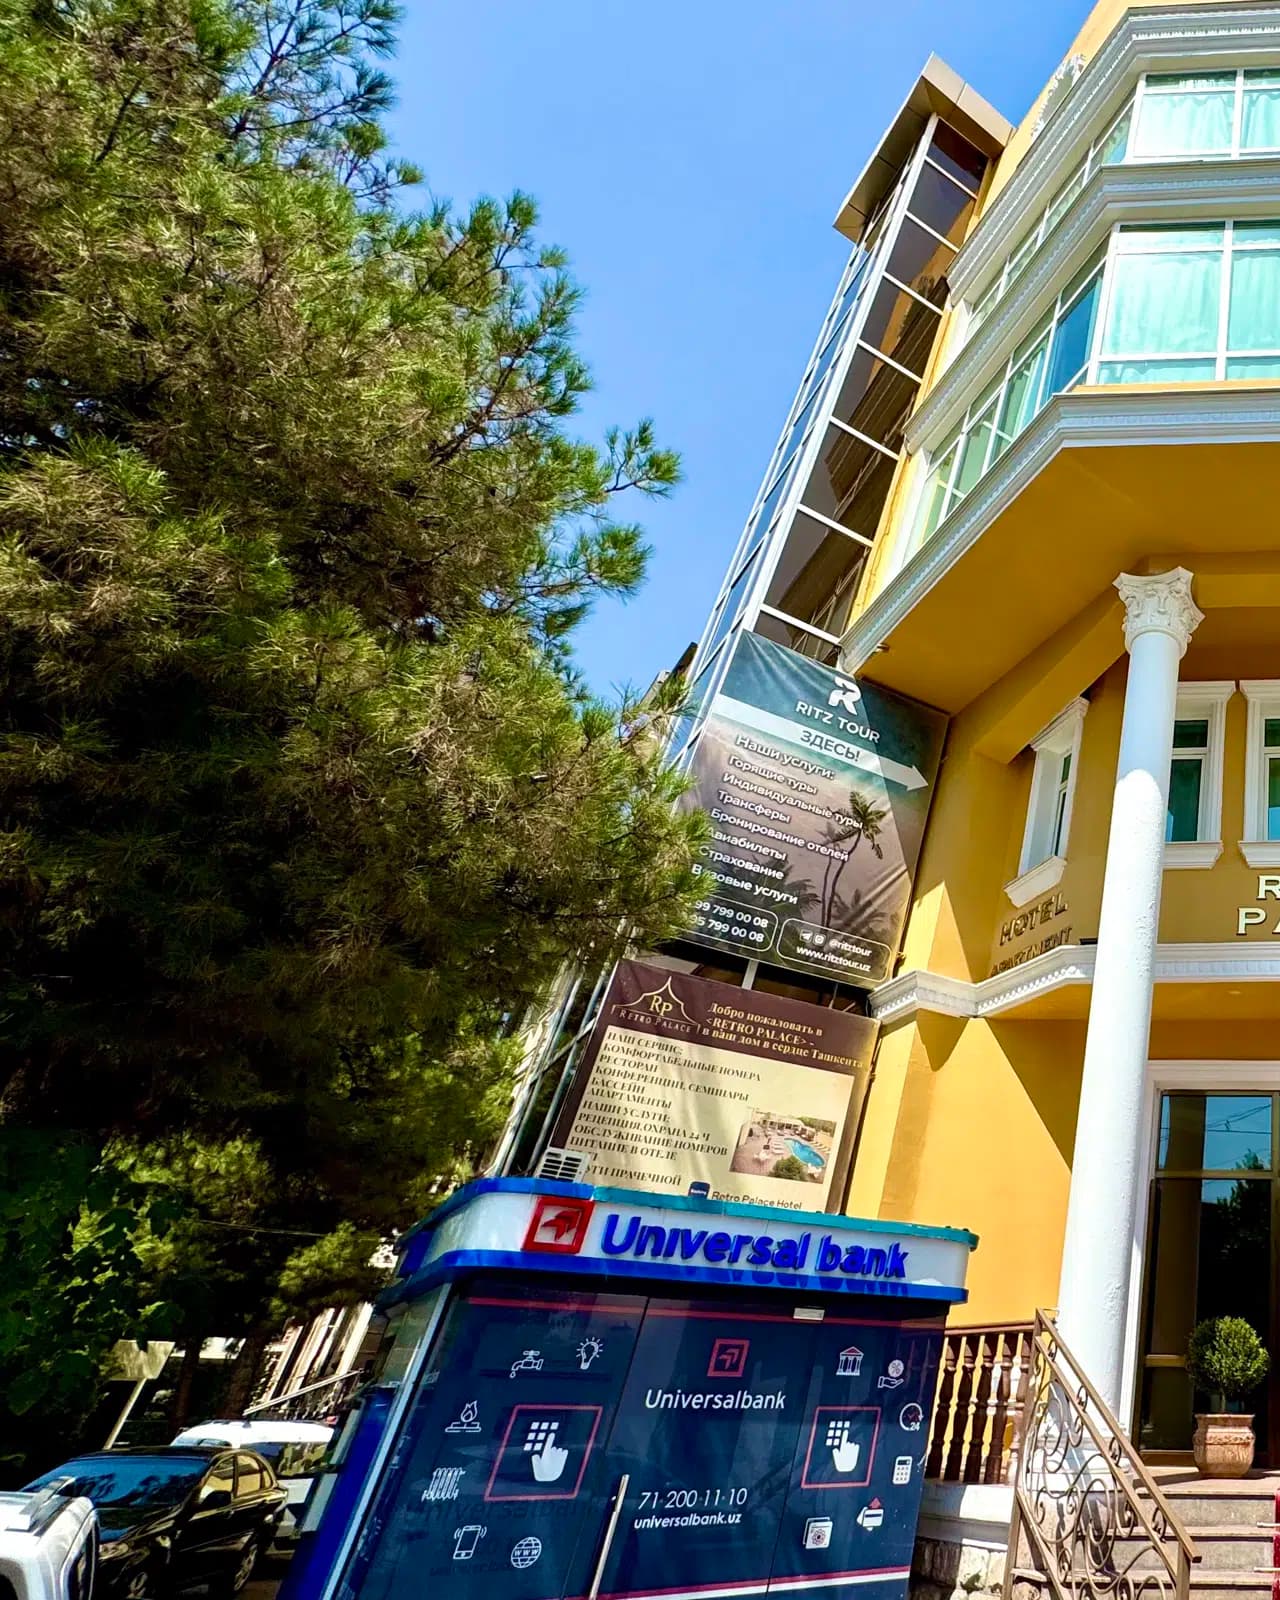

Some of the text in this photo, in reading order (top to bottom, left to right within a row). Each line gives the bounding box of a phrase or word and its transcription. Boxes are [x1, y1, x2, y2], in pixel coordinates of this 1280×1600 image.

[796, 700, 881, 744] RITZ TOUR
[735, 734, 835, 781] Наши услуги:
[799, 729, 861, 763] ЗДЕСЬ!
[728, 755, 818, 796] Горящие туры
[718, 790, 791, 824] Трансферы
[722, 772, 863, 830] Индивидуальные туры
[710, 808, 850, 862] Бронирование отелей
[698, 845, 785, 881] Страхование
[691, 863, 799, 905] Взовые услуги
[712, 905, 735, 919] 799
[736, 911, 752, 923] 00
[753, 916, 769, 929] 08
[999, 892, 1069, 946] HOTEL
[707, 919, 730, 932] 799
[731, 926, 747, 938] 00
[749, 931, 765, 943] 08
[796, 945, 872, 972] www.ritztour.uz
[829, 938, 873, 957] @ritztour
[619, 1008, 692, 1034] RETRO PALACE
[707, 1002, 823, 1037] Добро пожаловать в
[606, 1033, 637, 1047] НАШ
[702, 1028, 710, 1037] в
[711, 1029, 737, 1044] ваш
[737, 1035, 762, 1049] дом
[763, 1041, 771, 1050] в
[771, 1041, 810, 1058] сердце
[598, 1054, 658, 1073] РЕСТОРАН
[602, 1043, 762, 1082] КОМФОРТАБЕЛЬНЫЕ НОМЕРА
[588, 1088, 673, 1109] АПАРТАМЕНТЫ
[591, 1076, 646, 1095] БАССЕЙН
[688, 1083, 750, 1102] СЕМИНАРЫ
[582, 1100, 623, 1115] НАШИ
[569, 1136, 630, 1155] ПИТАНИЕ
[630, 1145, 639, 1155] В
[640, 1147, 678, 1161] ОТЕЛЕ
[574, 1124, 728, 1156] ОБСЛУЖИВАНИЕ НОМЕРОВ
[610, 1167, 682, 1186] ПРАЧЕЧНОЙ
[711, 1190, 802, 1210] Retro Palace Hotel
[600, 1213, 909, 1279] Universal bank
[644, 1389, 787, 1410] Universalbank
[633, 1511, 743, 1530] universalbank.uz
